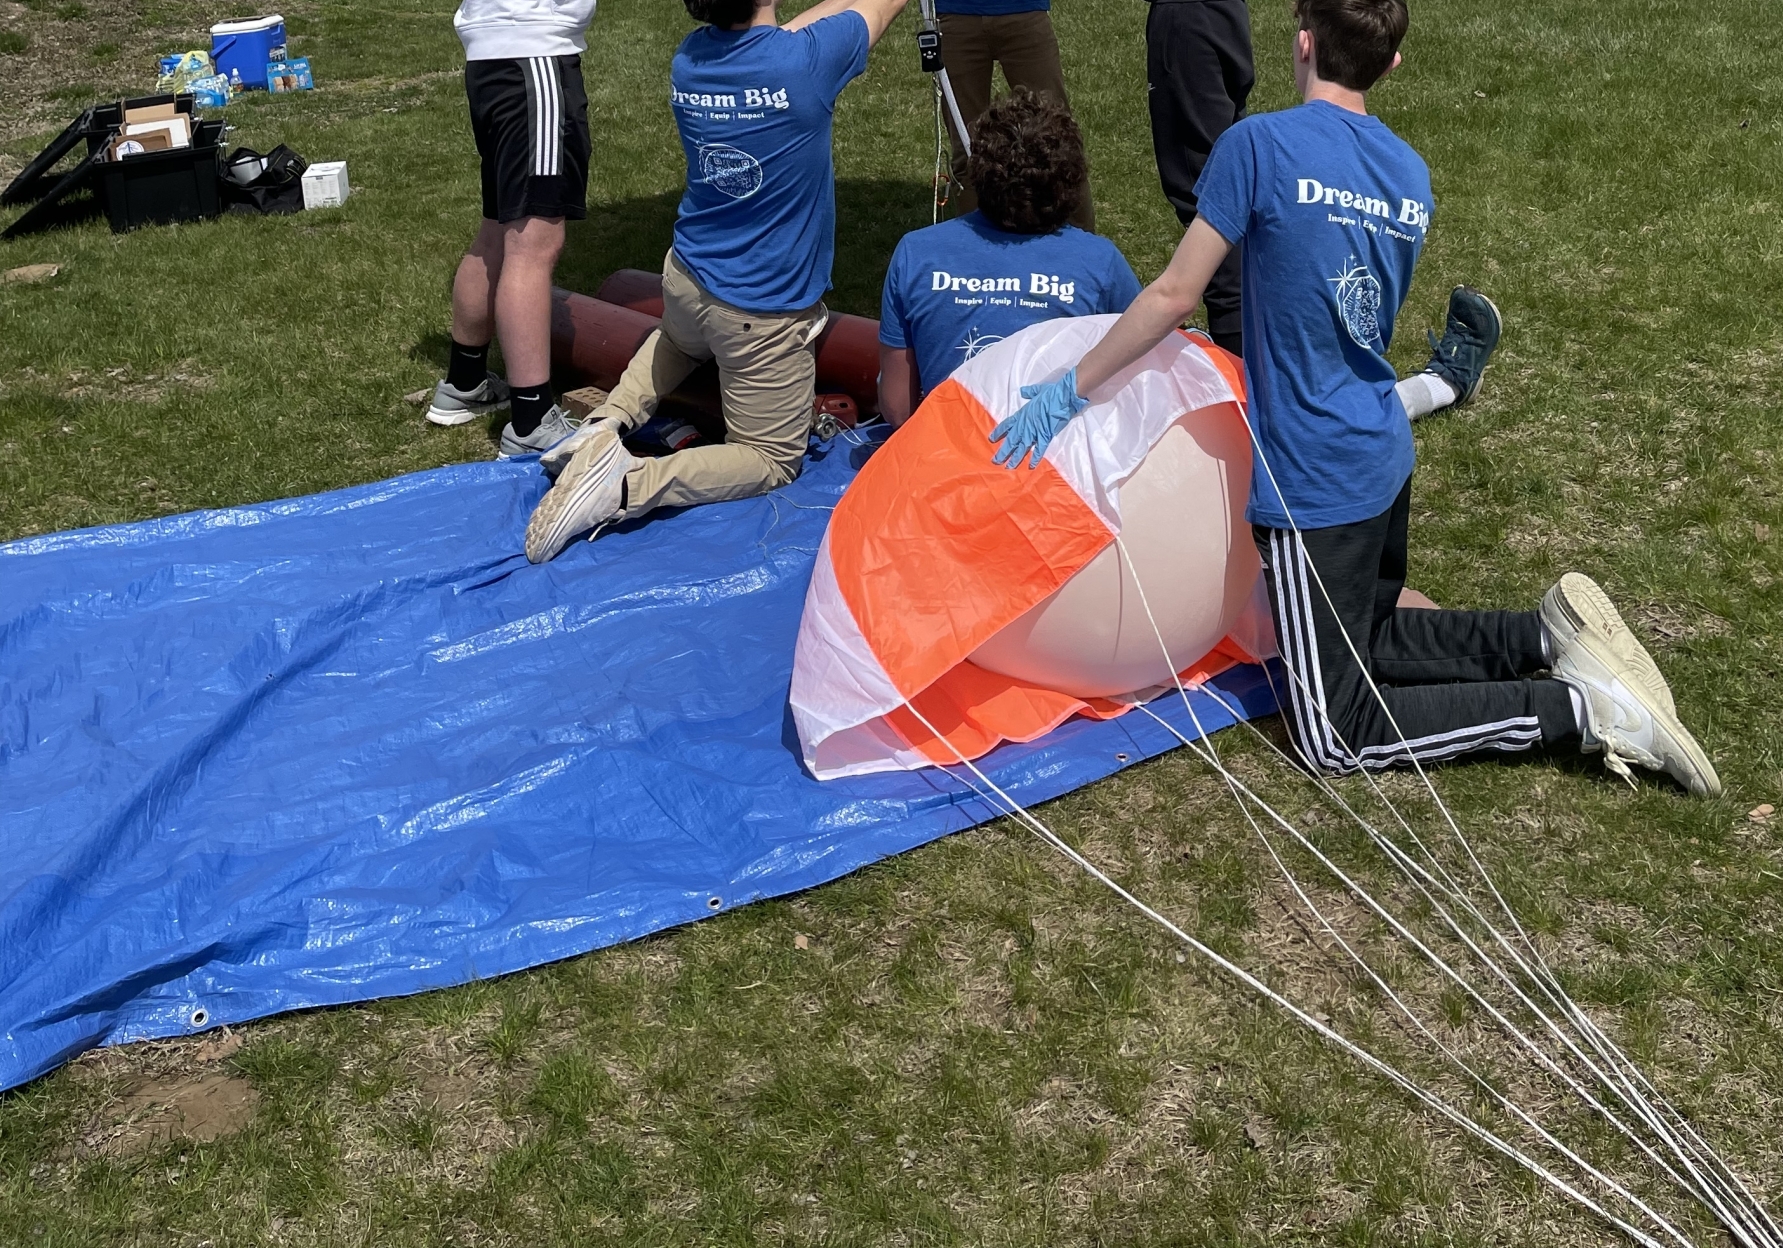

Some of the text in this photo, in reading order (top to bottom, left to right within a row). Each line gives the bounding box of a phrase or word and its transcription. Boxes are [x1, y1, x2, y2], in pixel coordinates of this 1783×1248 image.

[744, 87, 789, 109] Big
[710, 112, 730, 120] Equip
[738, 112, 765, 120] Impact
[1297, 178, 1390, 218] Dream
[1385, 226, 1416, 243] Impact
[932, 271, 1075, 304] Dream Big
[955, 297, 1049, 308] Inspire Equip Impact
